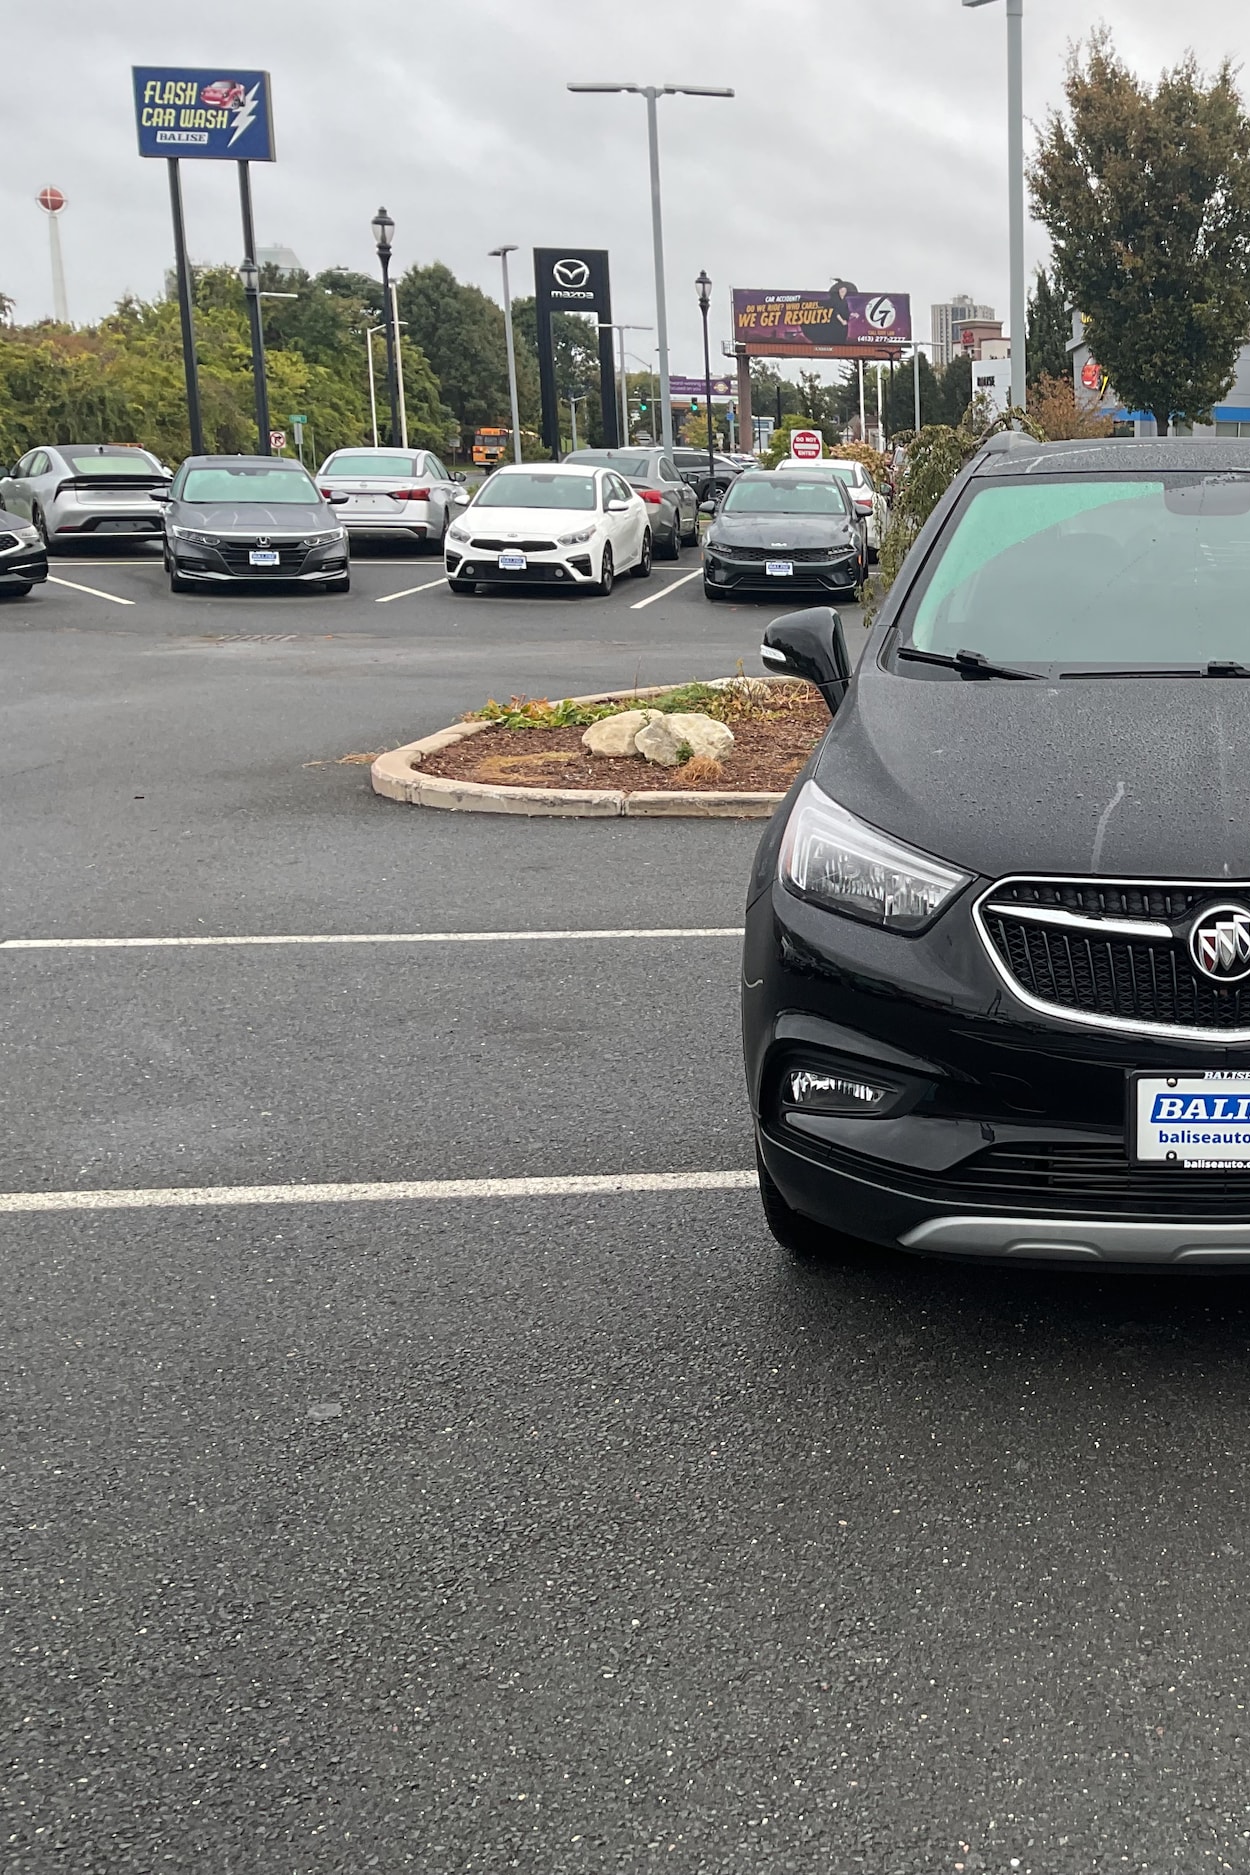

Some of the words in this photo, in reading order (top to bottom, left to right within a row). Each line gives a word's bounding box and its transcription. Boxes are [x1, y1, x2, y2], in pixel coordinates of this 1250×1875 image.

[144, 81, 198, 105] FLASH
[141, 107, 176, 127] CAR
[179, 109, 229, 129] WASH
[160, 133, 206, 142] BALISE
[739, 313, 757, 327] WE
[760, 311, 781, 326] GET
[784, 308, 834, 325] RESULTS!
[746, 305, 754, 313] DO
[756, 304, 766, 312] WE
[767, 303, 784, 312] RIDE?
[785, 303, 800, 311] WHO
